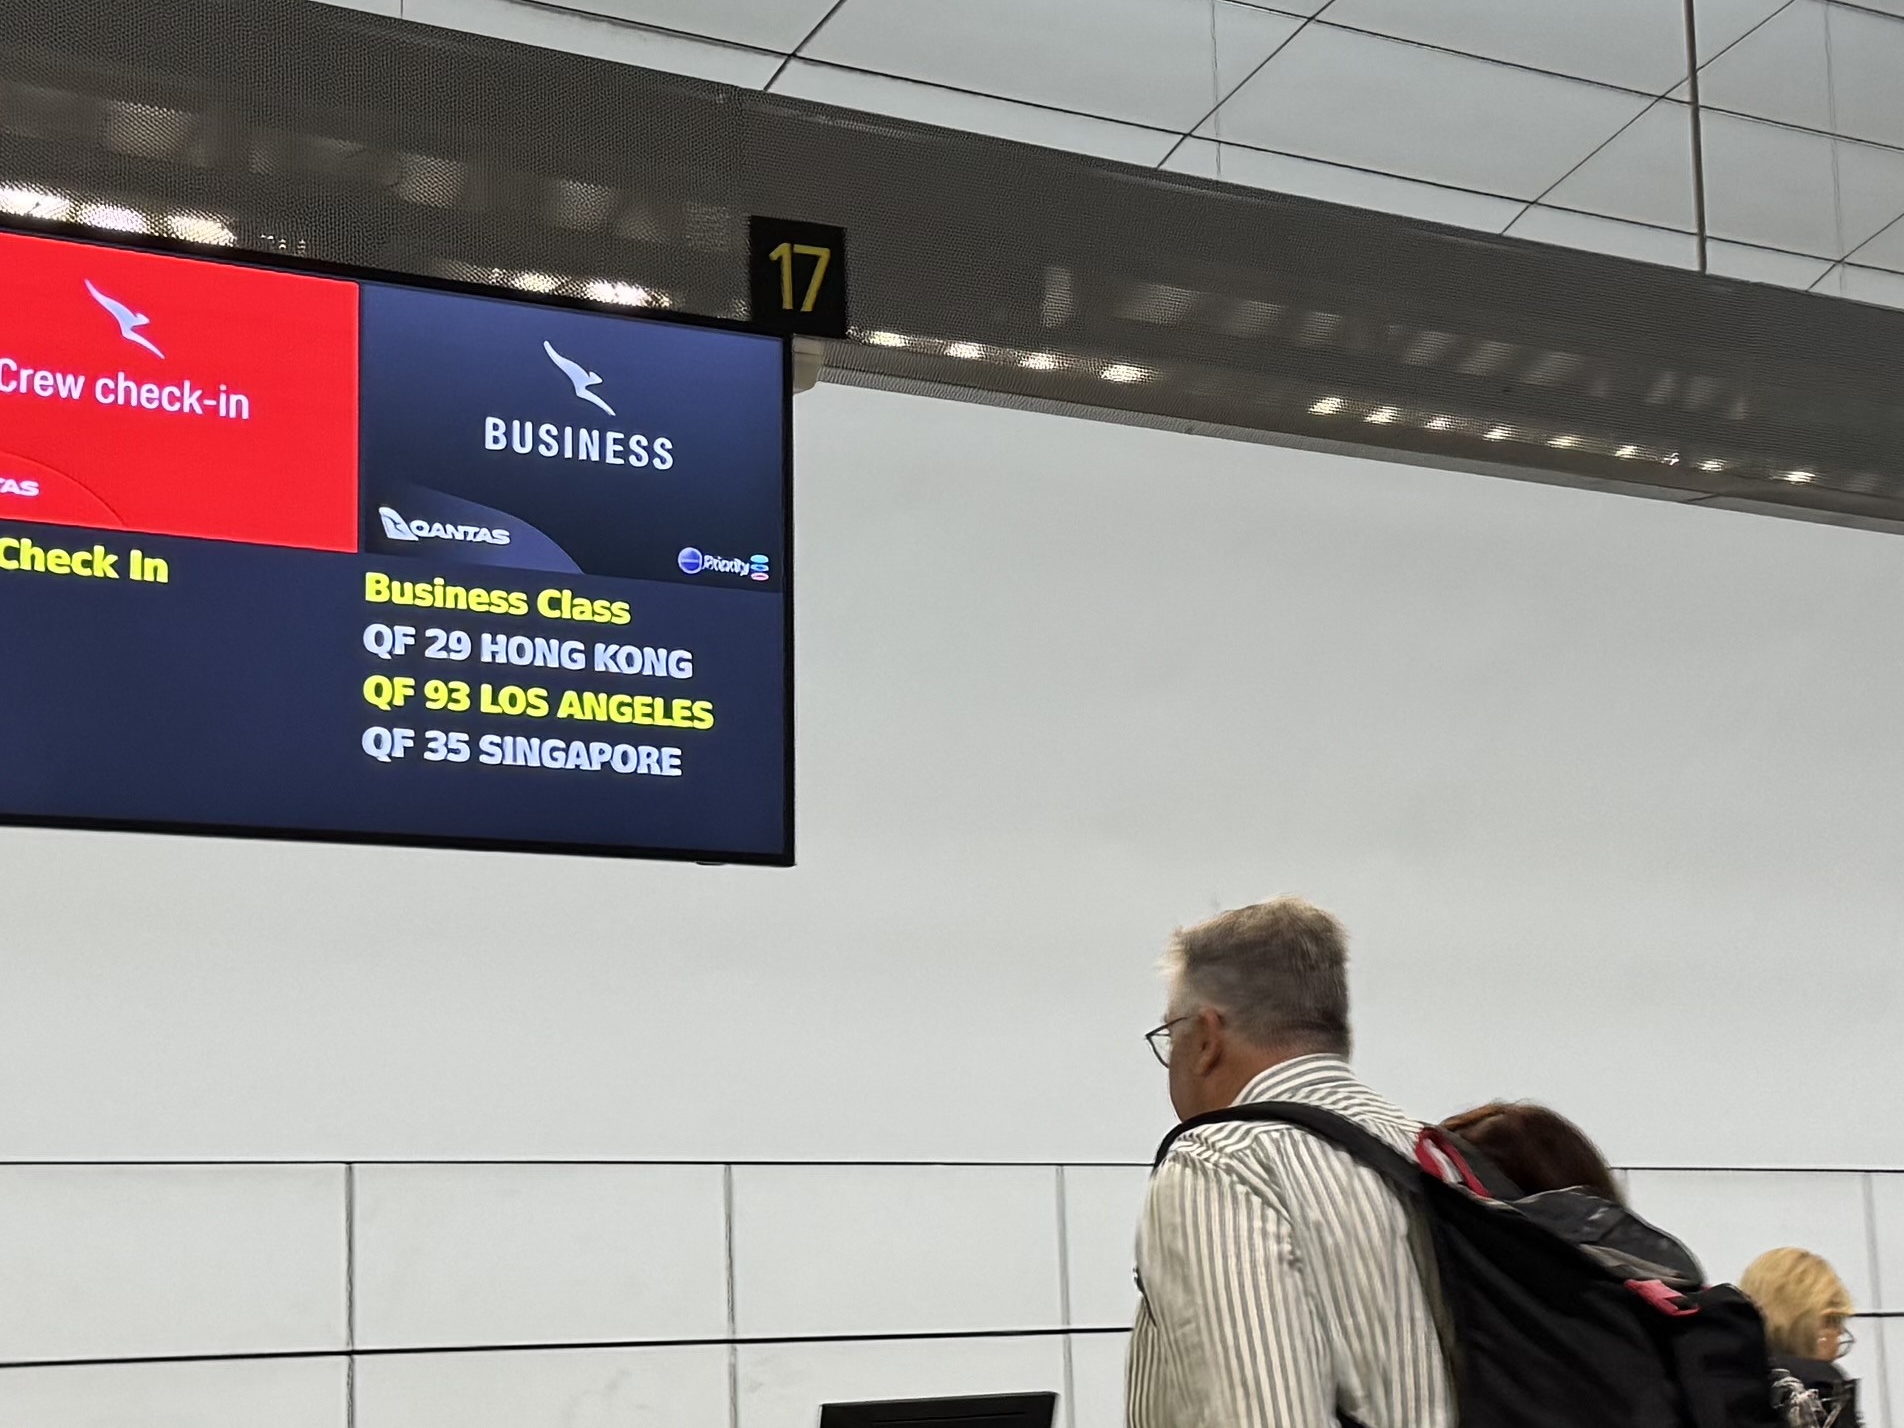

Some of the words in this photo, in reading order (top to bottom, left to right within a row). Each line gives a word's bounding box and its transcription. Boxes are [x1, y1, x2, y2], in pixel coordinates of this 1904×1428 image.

[769, 242, 831, 312] 17
[94, 372, 251, 420] check-in
[484, 416, 674, 470] BUSINESS
[410, 519, 511, 545] QANTAS
[129, 548, 170, 584] In
[365, 571, 529, 616] Business
[536, 588, 632, 625] Class
[362, 623, 416, 660] QF
[424, 628, 472, 661] 29
[480, 632, 586, 671] HONG
[594, 642, 694, 679] KONG
[362, 674, 416, 711] QF
[423, 679, 471, 712] 93
[480, 683, 549, 718] LOS
[556, 690, 715, 730] ANGELES
[361, 726, 415, 763] QF
[423, 730, 471, 763] 35
[479, 734, 683, 777] SINGAPORE
